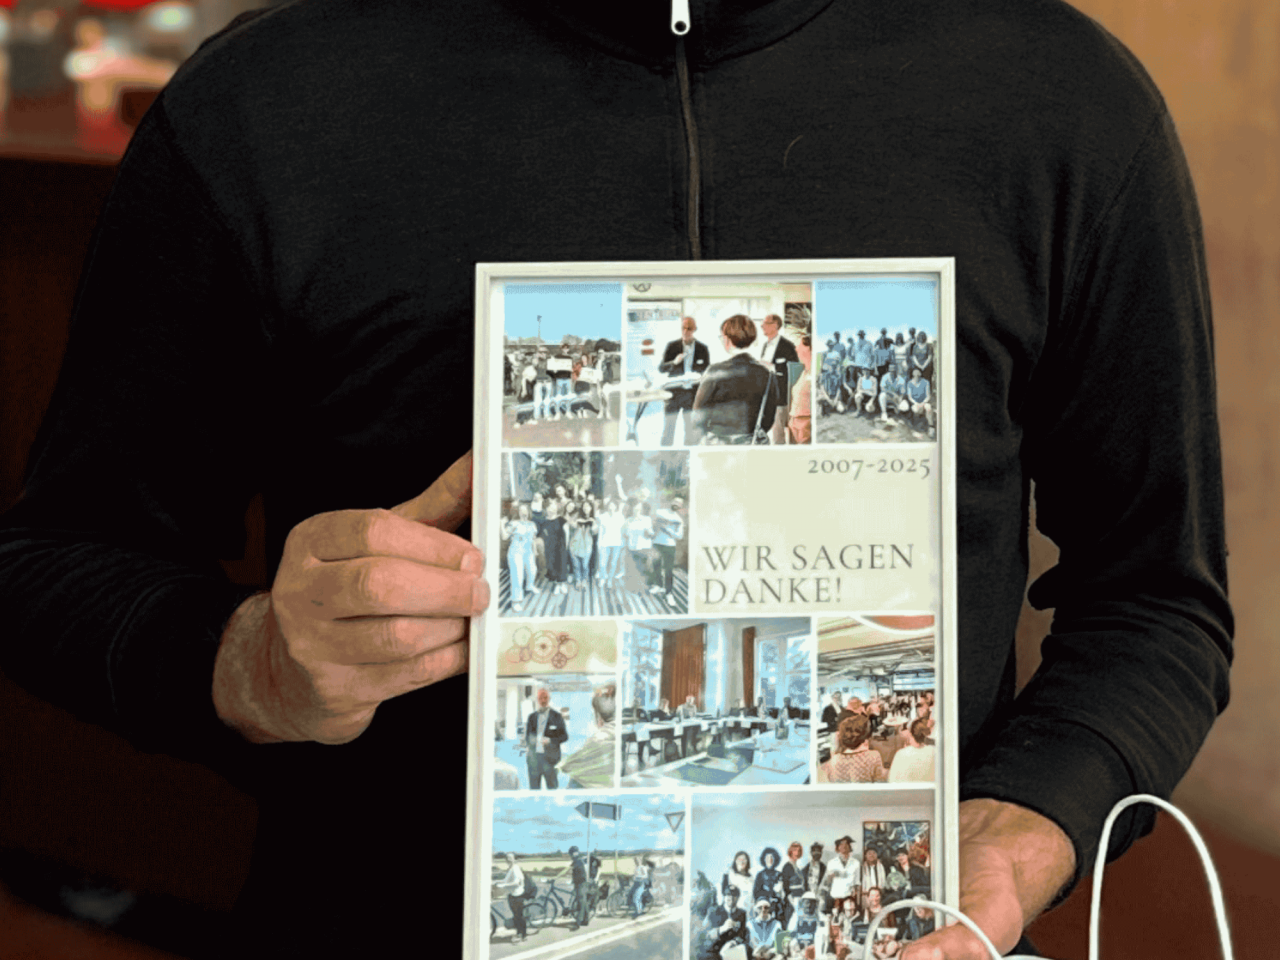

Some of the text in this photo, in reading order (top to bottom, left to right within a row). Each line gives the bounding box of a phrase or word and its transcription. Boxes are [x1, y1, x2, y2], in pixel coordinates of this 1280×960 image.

[807, 458, 932, 480] 2007-2025
[702, 543, 915, 572] WIR SAGEN
[703, 577, 842, 605] DANKE!
